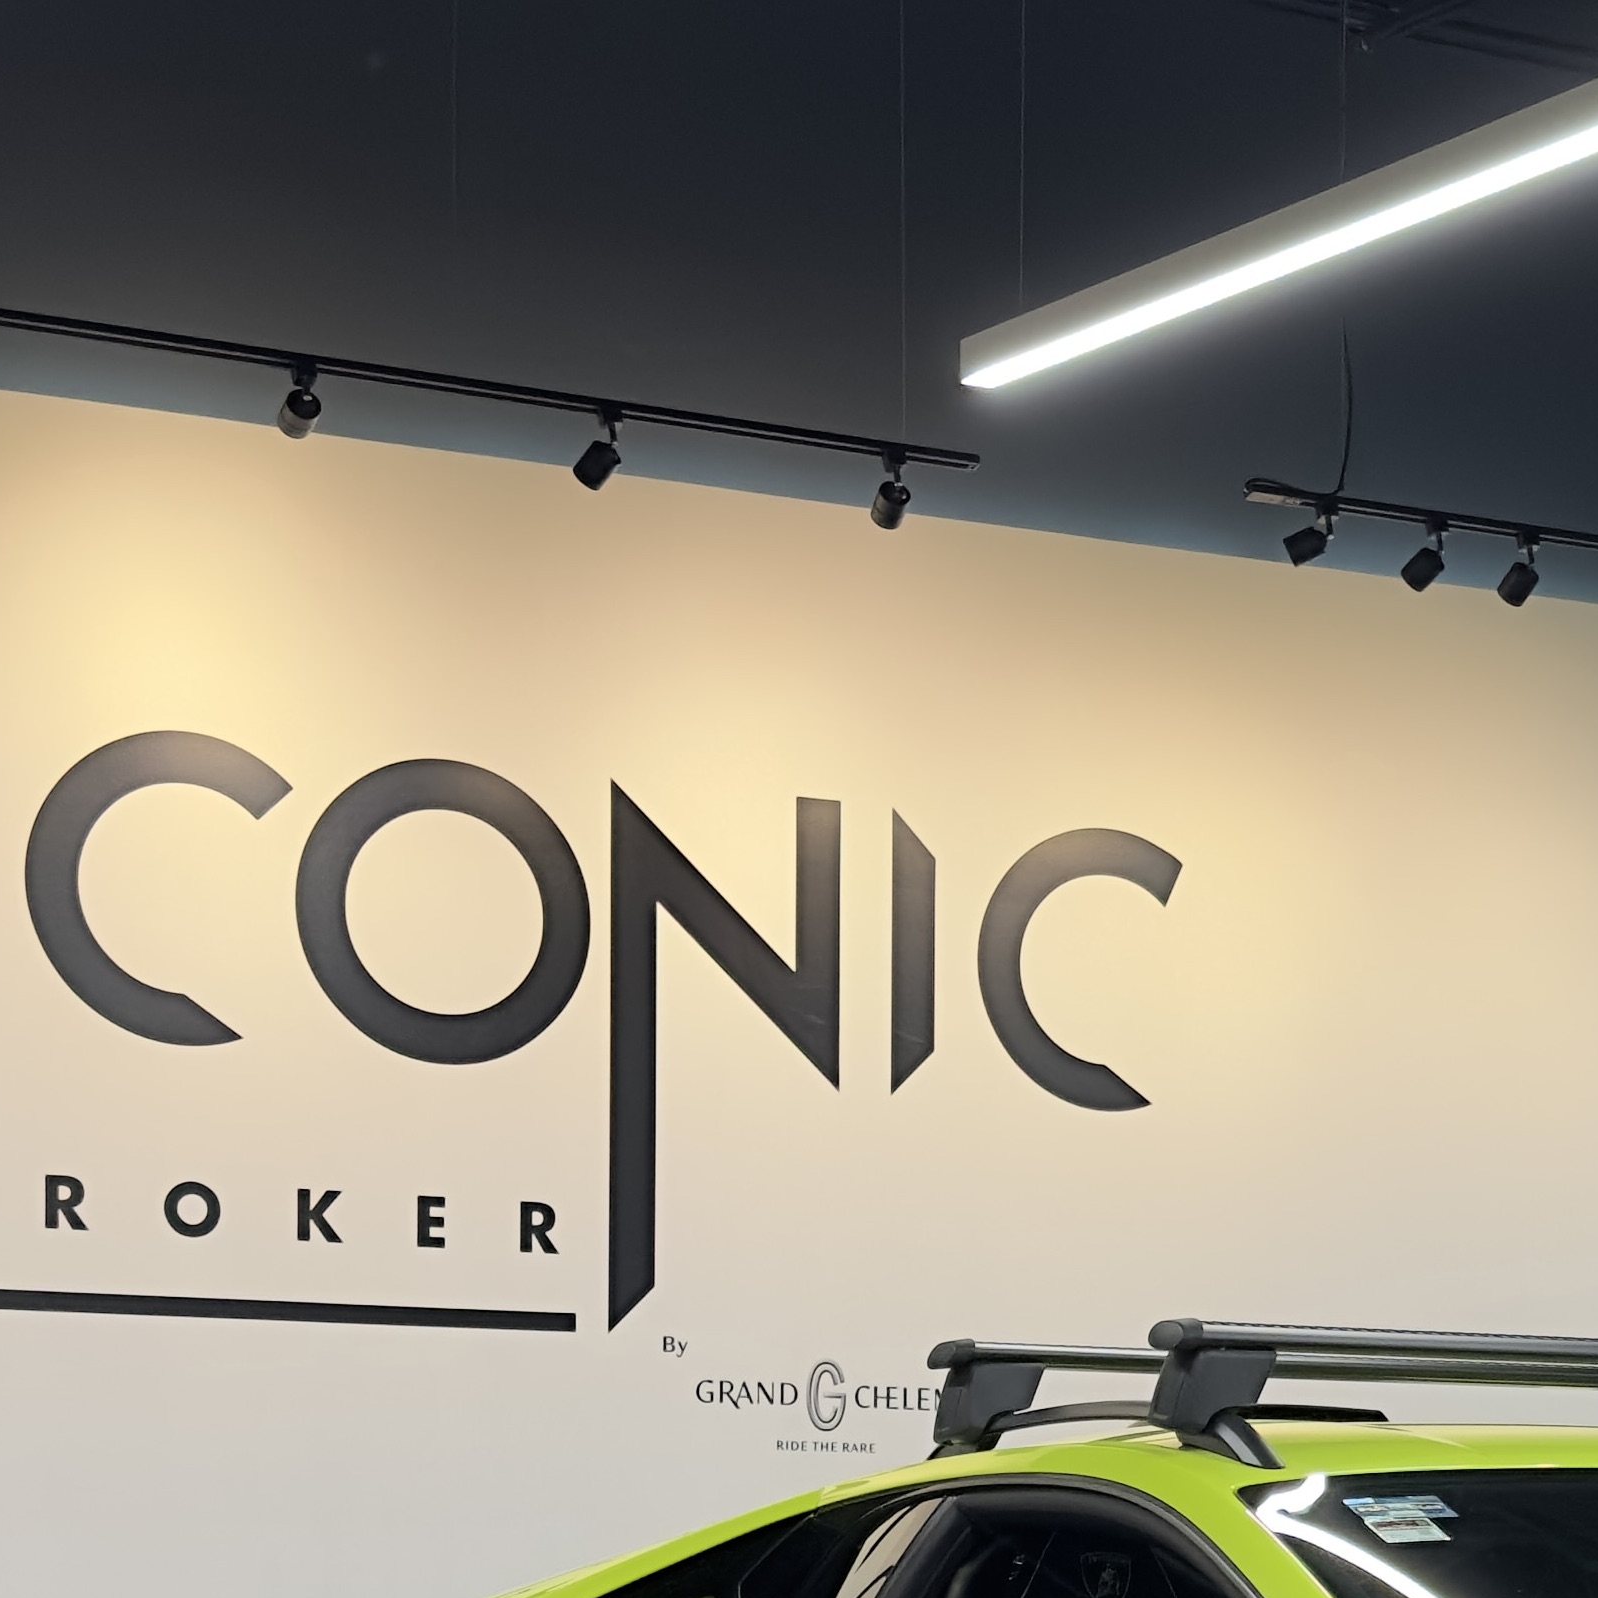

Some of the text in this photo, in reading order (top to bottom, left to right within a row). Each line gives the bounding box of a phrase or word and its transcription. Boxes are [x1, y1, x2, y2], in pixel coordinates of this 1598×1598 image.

[662, 1335, 688, 1358] By
[695, 1379, 799, 1410] GRAND
[854, 1385, 942, 1412] CHELE
[776, 1439, 876, 1454] RIDE THE RARE
